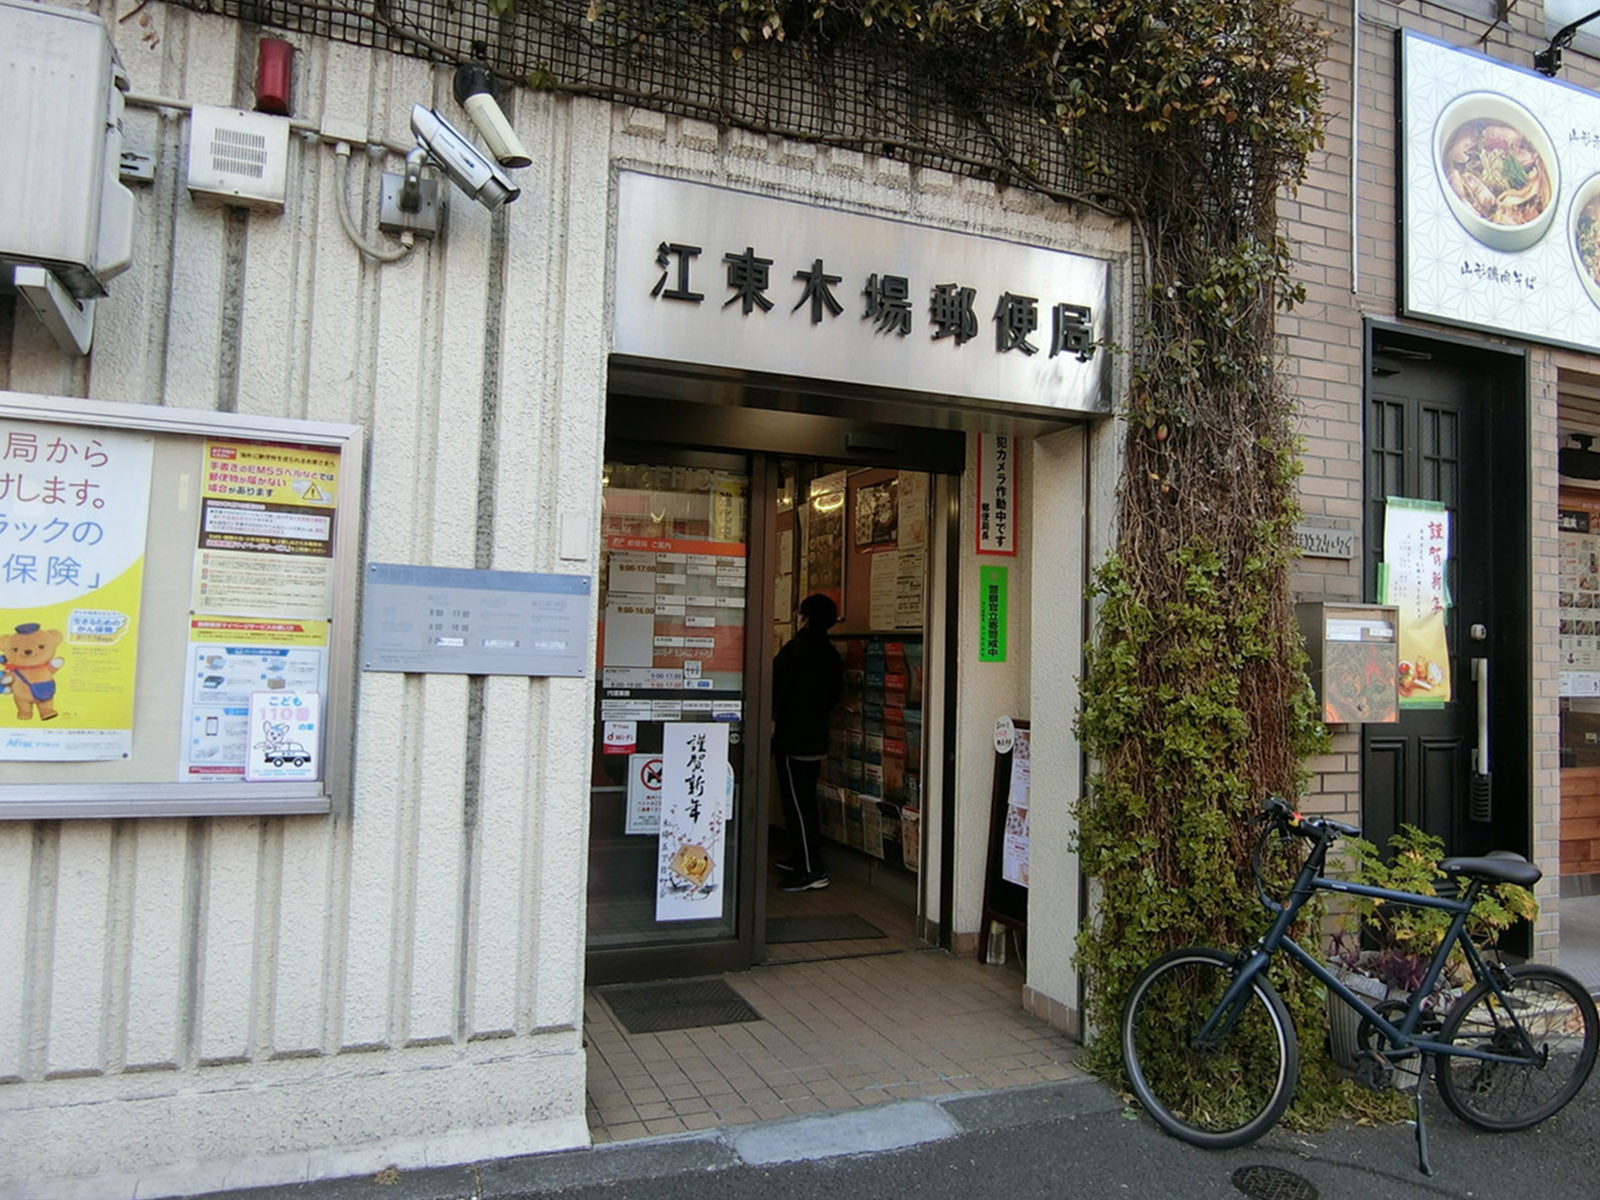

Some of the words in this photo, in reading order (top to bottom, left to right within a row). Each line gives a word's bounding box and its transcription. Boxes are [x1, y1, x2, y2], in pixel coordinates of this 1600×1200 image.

[650, 241, 1096, 363] 江東木場郵便局
[208, 483, 274, 497] 場合があります
[209, 472, 287, 487] 郵便物が届かない
[1427, 521, 1444, 616] 謹賀新年
[269, 697, 303, 706] こども
[685, 733, 707, 824] 謹賀新年
